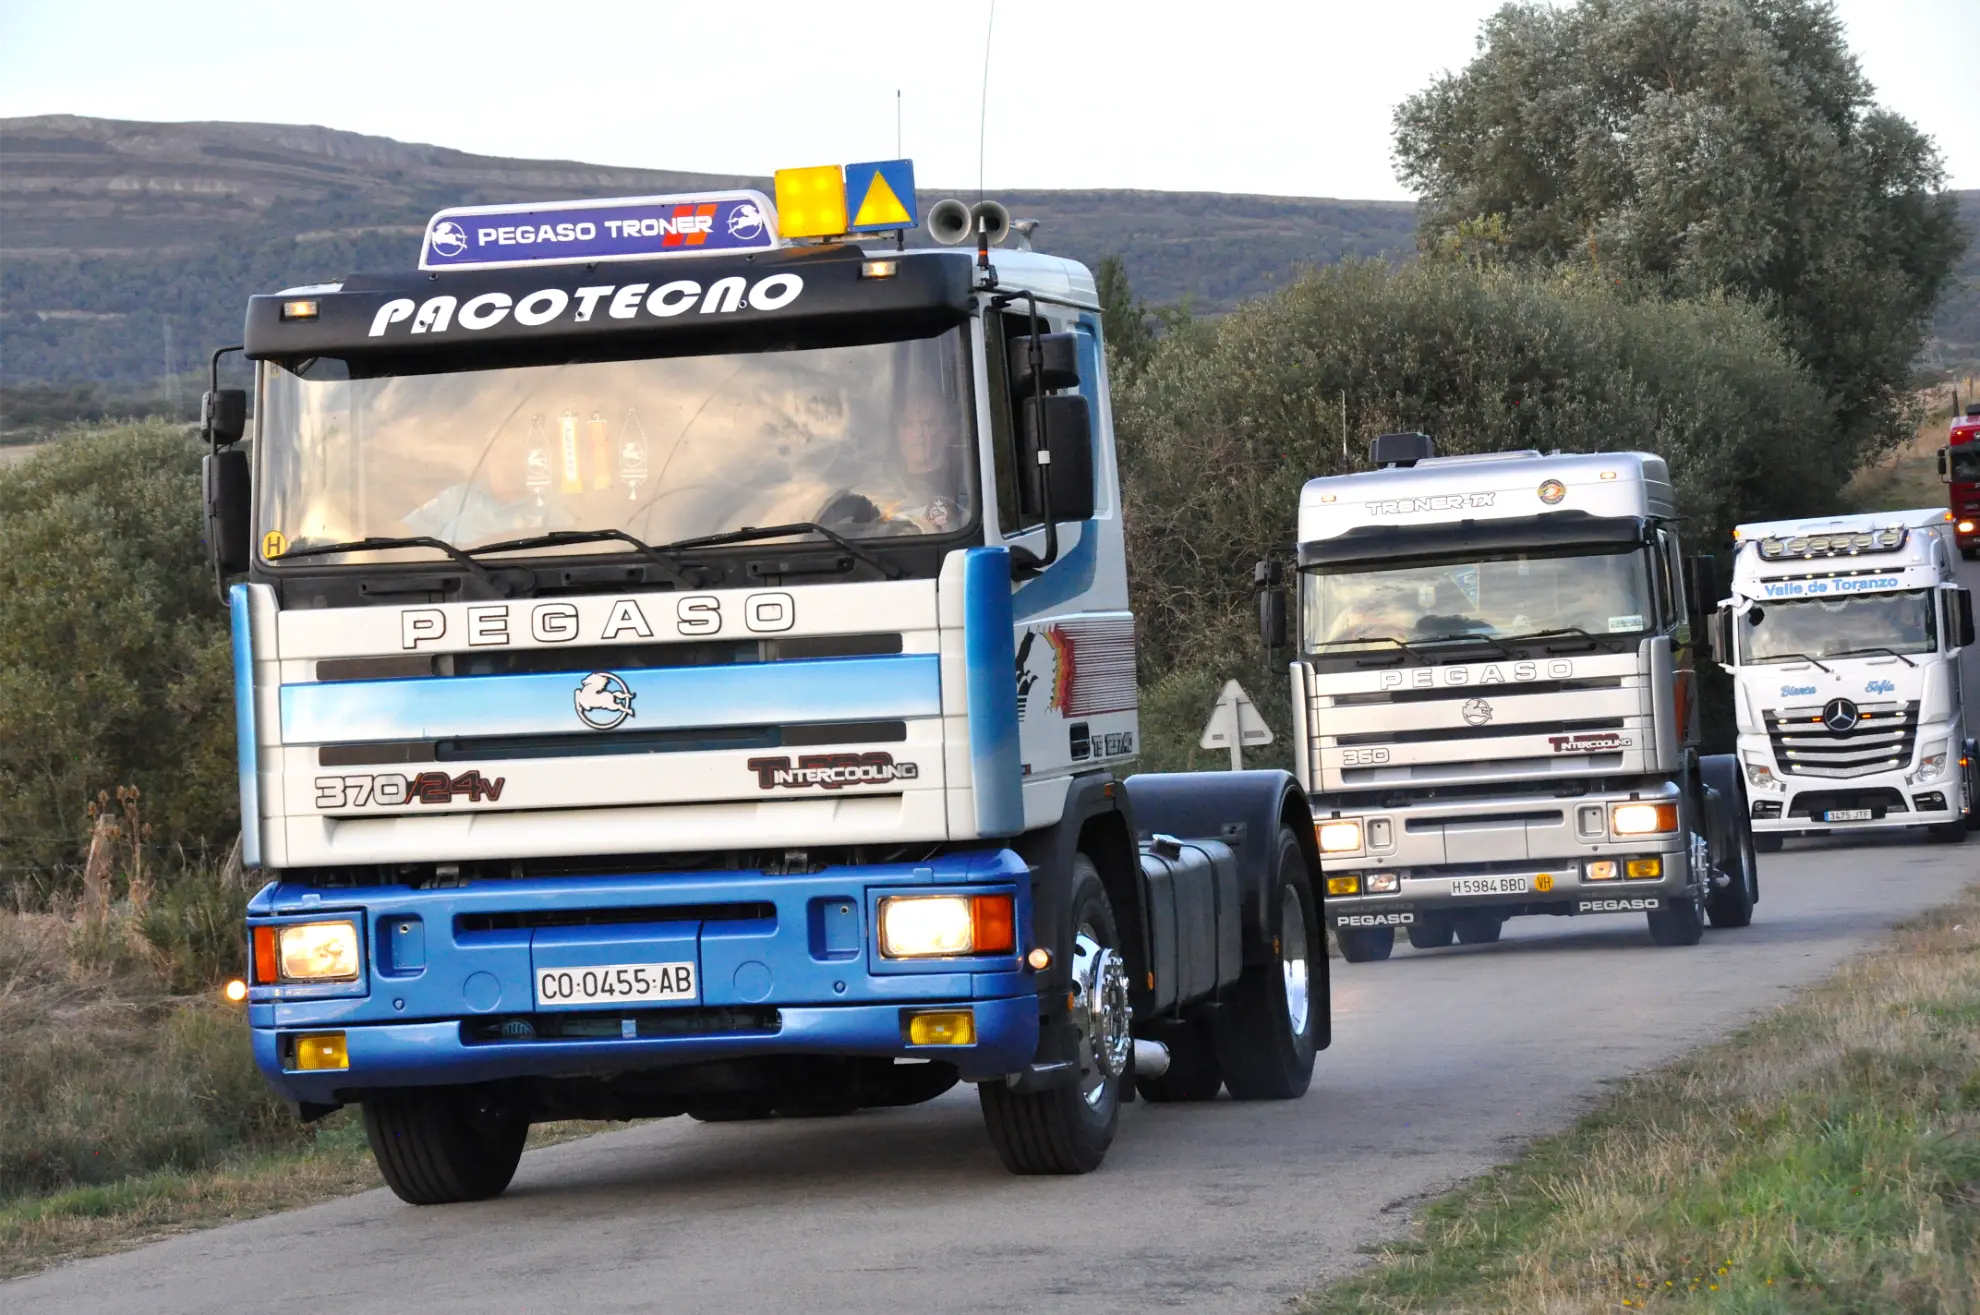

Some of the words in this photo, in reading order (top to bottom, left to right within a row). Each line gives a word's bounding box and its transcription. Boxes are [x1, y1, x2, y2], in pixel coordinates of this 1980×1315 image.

[478, 222, 597, 247] PEGASO
[604, 215, 714, 239] TRONER
[368, 273, 804, 338] PACOTECNO
[1366, 491, 1496, 516] TRONER-TX
[267, 536, 281, 556] H
[1764, 583, 1804, 597] Valle
[1808, 581, 1828, 594] de
[1831, 577, 1899, 592] Toranzo
[401, 592, 795, 650] PEGASO
[1380, 658, 1573, 691] PEGASO
[1780, 685, 1817, 698] Blanca
[1342, 747, 1390, 766] 360
[773, 762, 919, 785] INTERCOOLING
[1452, 880, 1461, 894] H
[1463, 879, 1498, 894] 5984
[1500, 878, 1527, 892] BBD
[1538, 875, 1552, 890] VH
[1579, 898, 1660, 912] PEGASO
[1337, 912, 1415, 927] PEGASO
